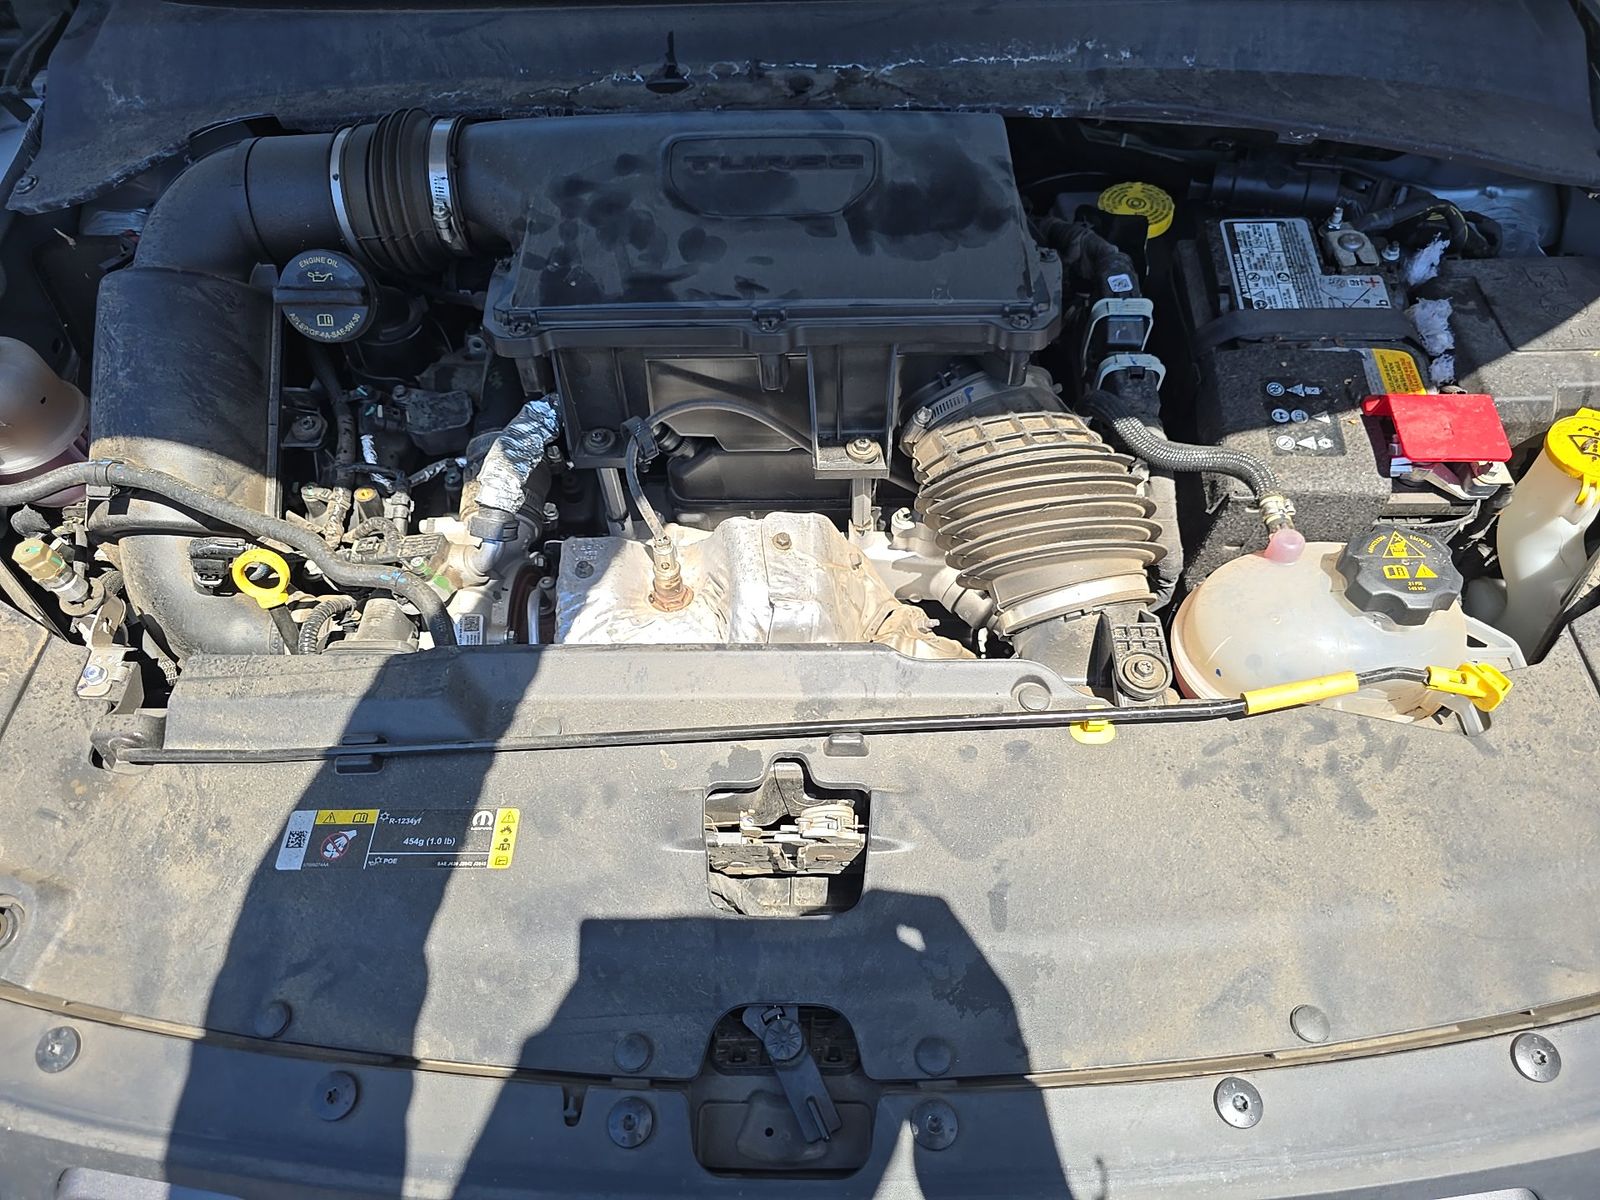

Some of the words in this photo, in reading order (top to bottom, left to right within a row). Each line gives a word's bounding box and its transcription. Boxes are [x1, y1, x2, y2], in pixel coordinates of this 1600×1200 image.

[299, 256, 325, 268] ENGINE
[327, 258, 339, 268] OIL
[388, 817, 422, 826] R-1234yf
[403, 838, 424, 846] 454g
[426, 837, 442, 846] (1.0
[443, 837, 456, 846] lb)
